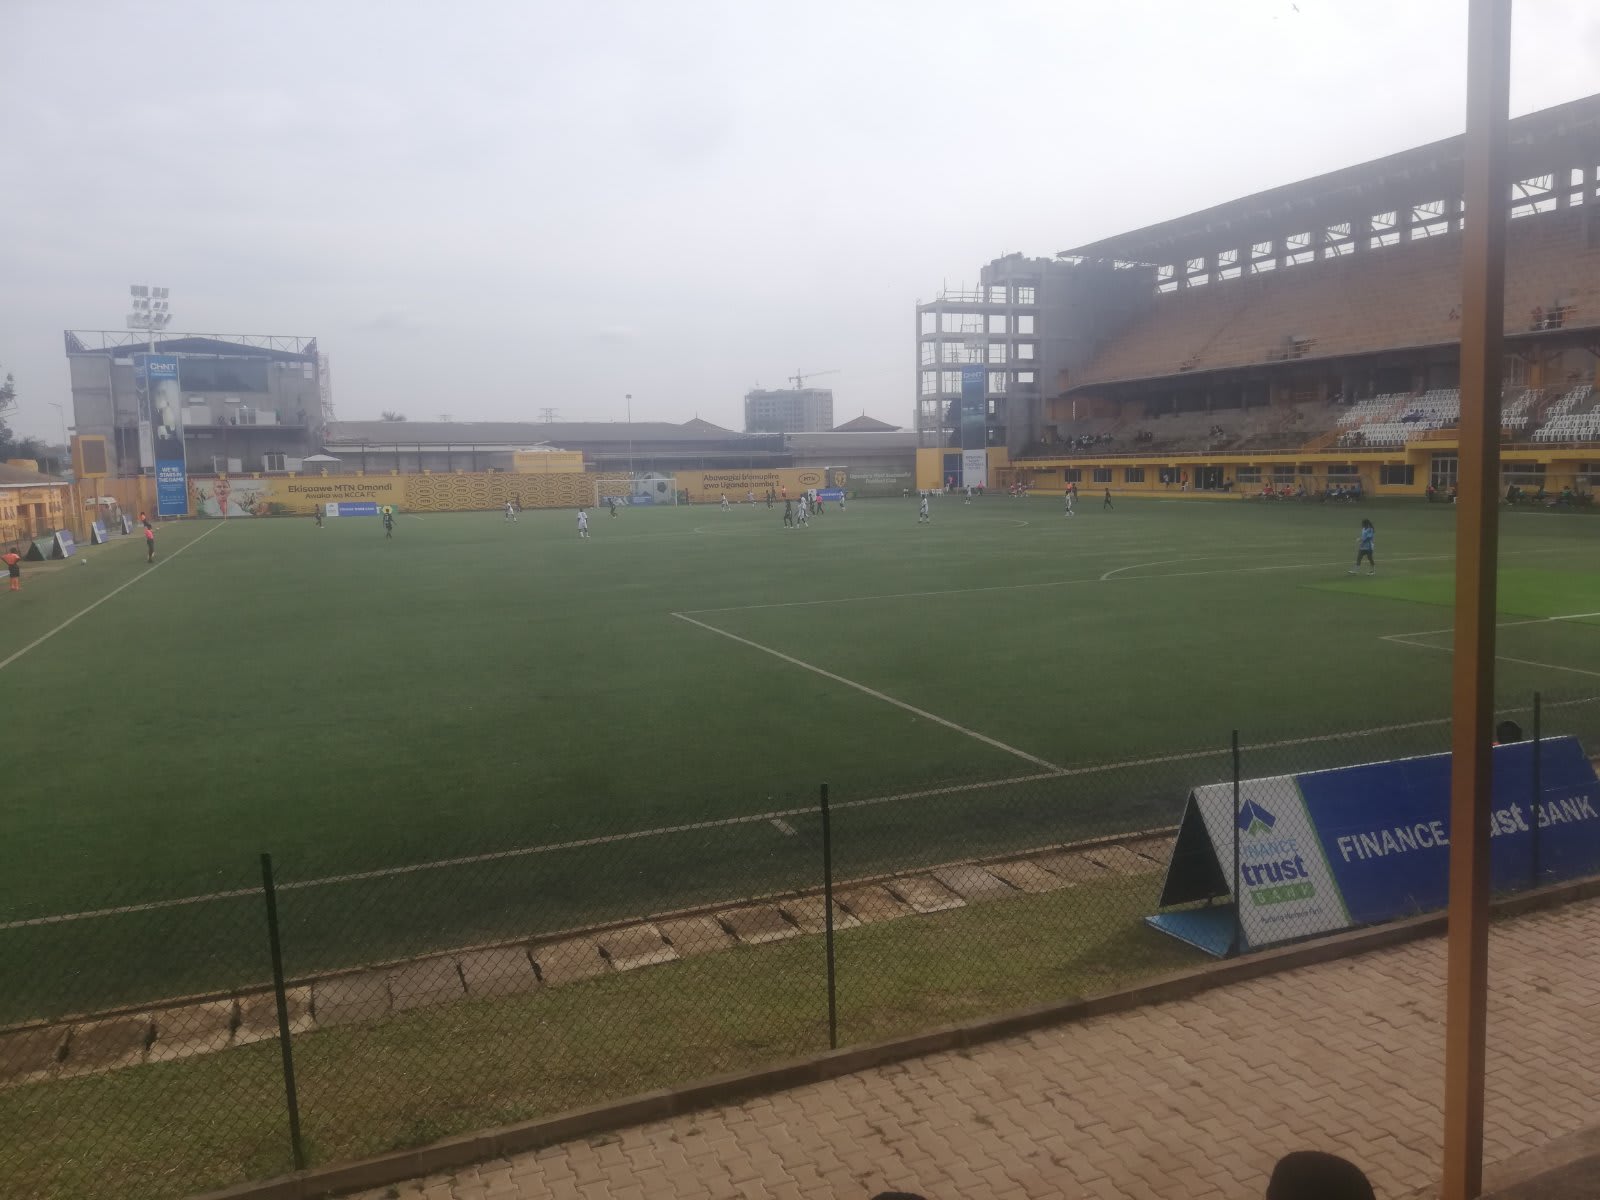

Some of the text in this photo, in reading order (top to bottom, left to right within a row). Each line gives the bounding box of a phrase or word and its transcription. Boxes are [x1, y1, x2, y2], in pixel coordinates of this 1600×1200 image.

[720, 481, 748, 489] Uganda
[1337, 821, 1451, 862] FINANCE
[1530, 796, 1598, 828] BANK
[1241, 853, 1309, 887] trust
